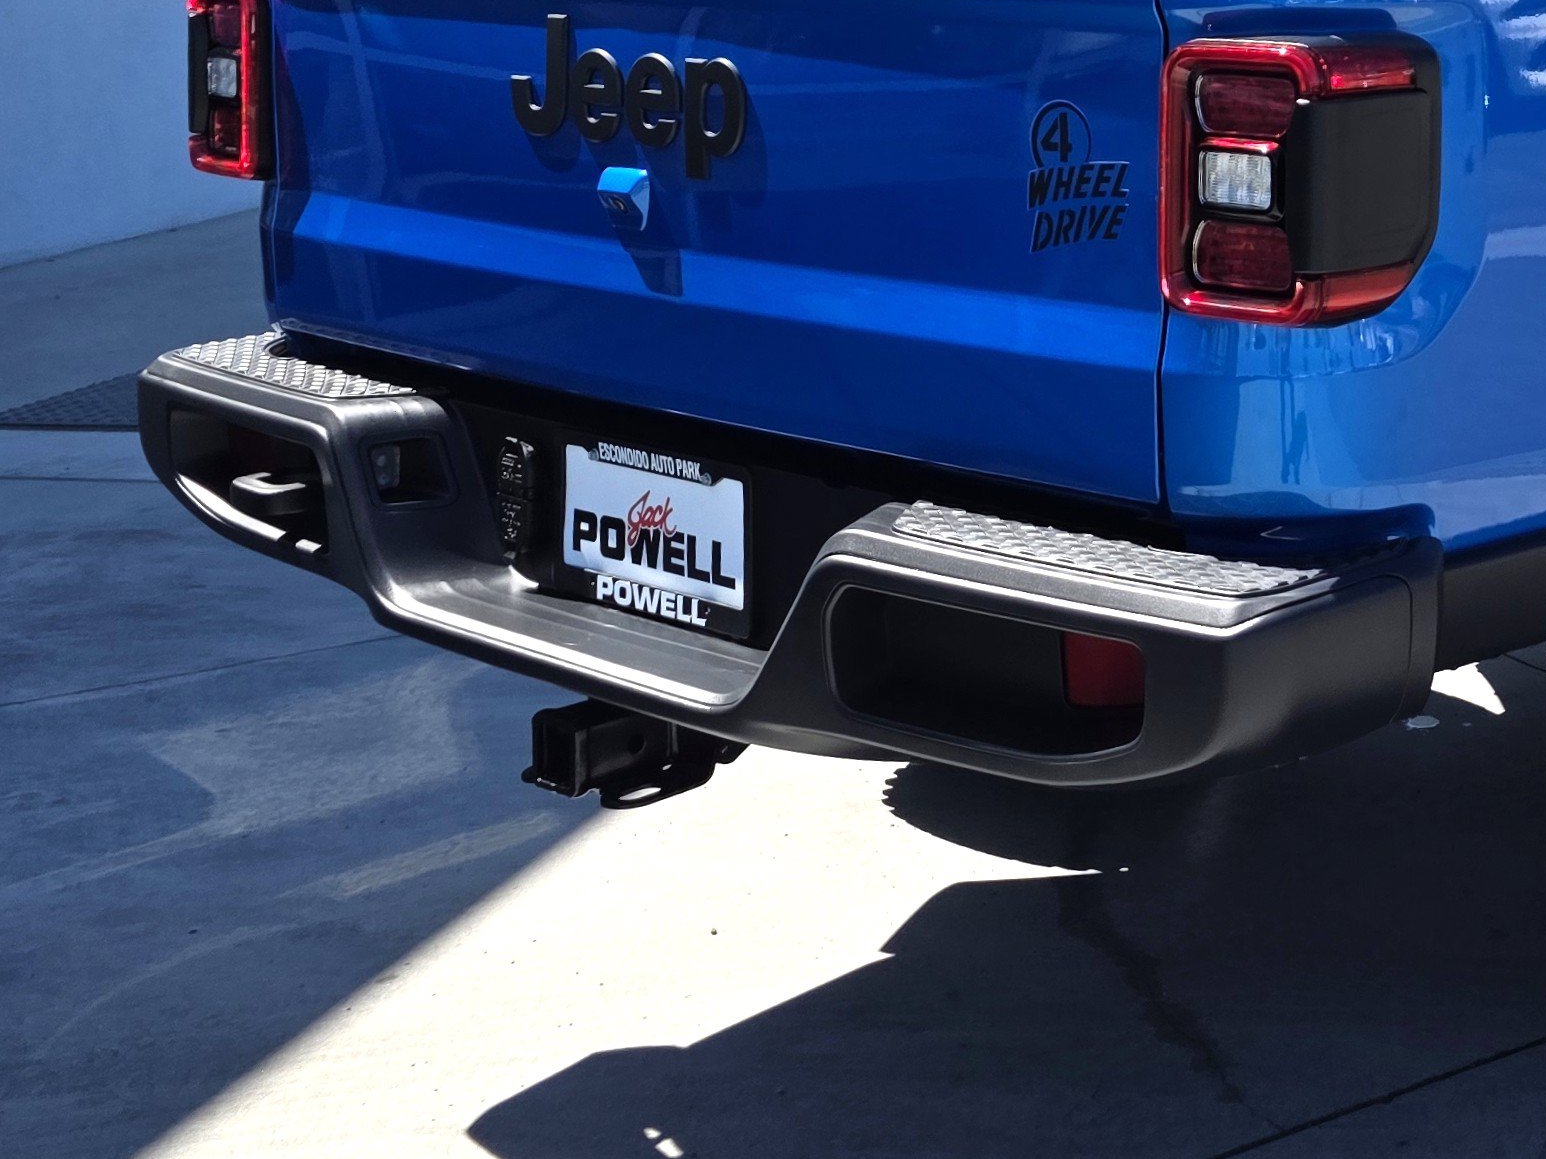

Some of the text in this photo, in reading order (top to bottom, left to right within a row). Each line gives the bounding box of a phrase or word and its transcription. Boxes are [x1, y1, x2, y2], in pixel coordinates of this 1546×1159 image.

[510, 13, 746, 179] Jeep
[1040, 112, 1073, 162] 4
[1028, 162, 1129, 210] WHEEL
[1030, 204, 1129, 253] DRIVE
[598, 442, 701, 481] ESCONDIDO AUTO PARK
[627, 490, 677, 547] Jack
[572, 508, 736, 590] POWELL
[596, 575, 707, 626] POWELL
